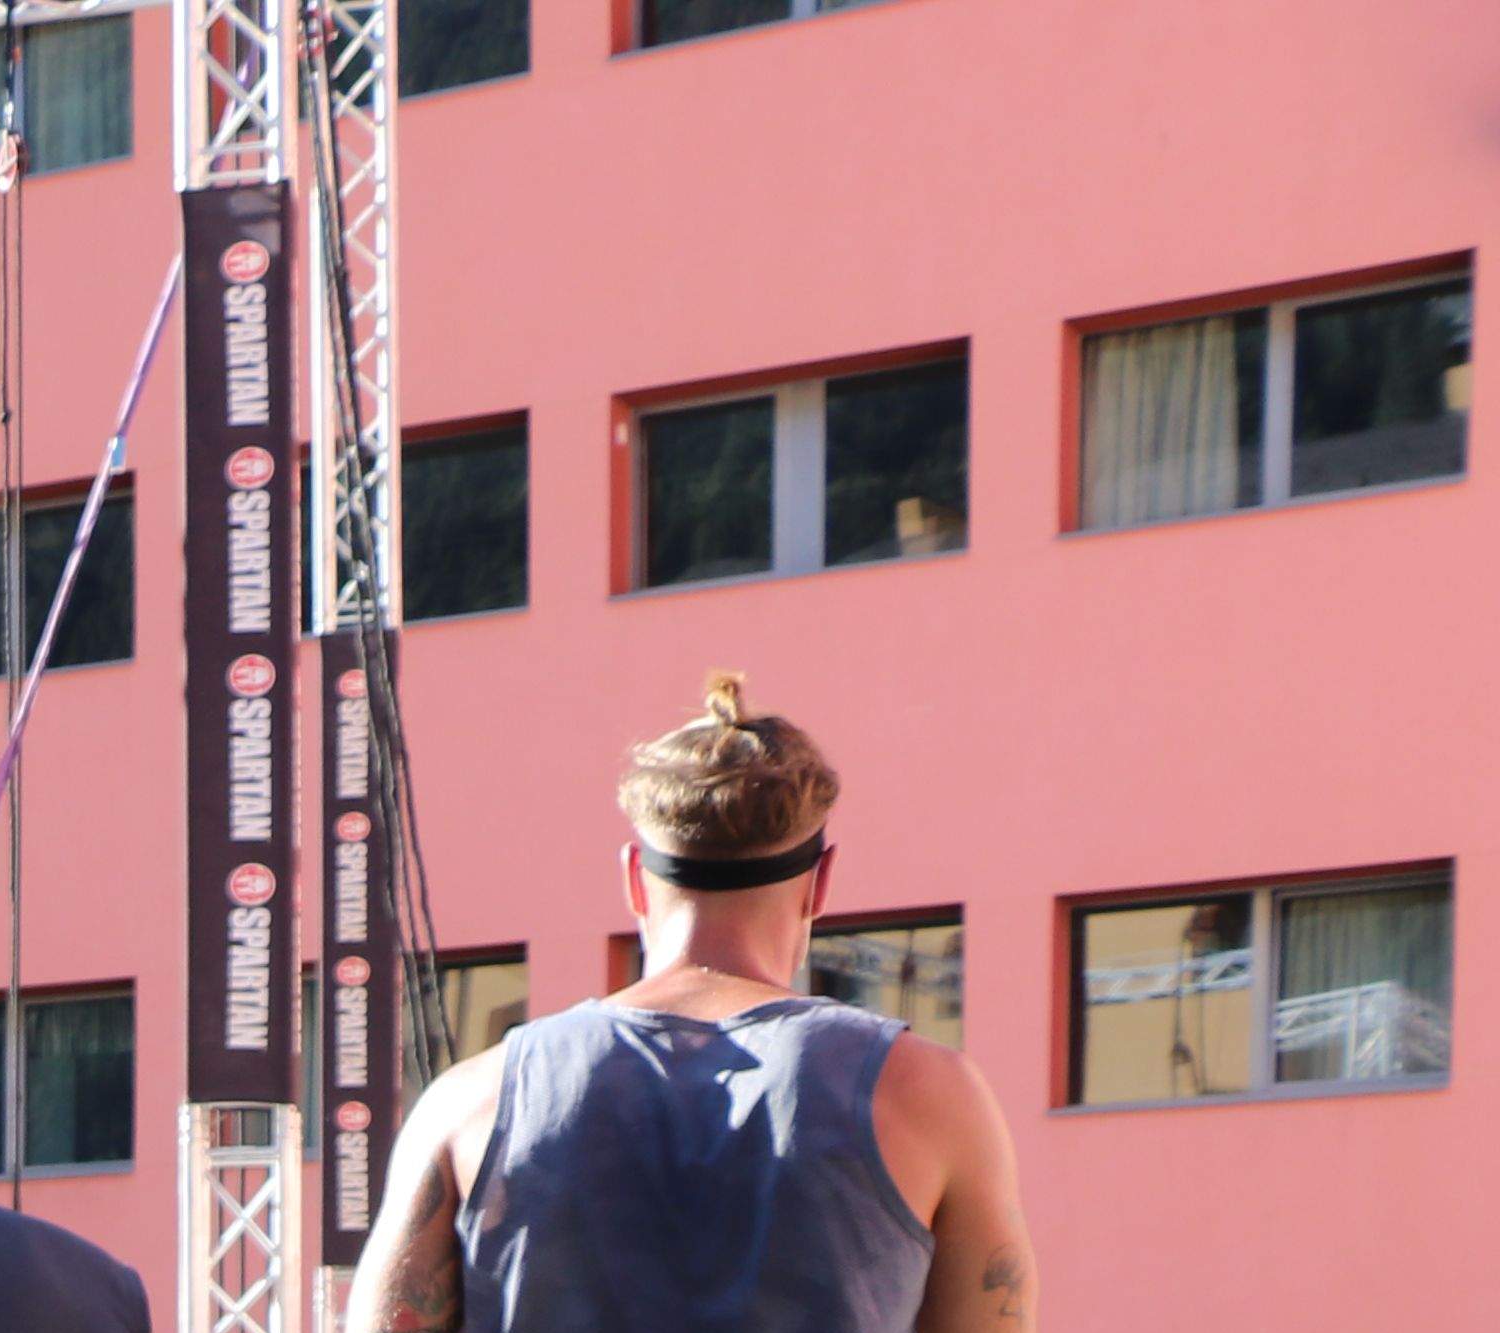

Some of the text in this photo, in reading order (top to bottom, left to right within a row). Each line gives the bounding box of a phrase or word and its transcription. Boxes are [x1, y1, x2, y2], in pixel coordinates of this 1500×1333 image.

[223, 283, 270, 427] SPARTAN
[226, 490, 271, 635] SPARTAN
[228, 697, 273, 842] SPARTAN
[336, 697, 369, 798] SPARTAN
[335, 842, 368, 943] SPARTAN
[225, 906, 271, 1051] SPARTAN
[334, 987, 368, 1088] SPARTAN
[336, 1131, 369, 1232] SPARTAN
